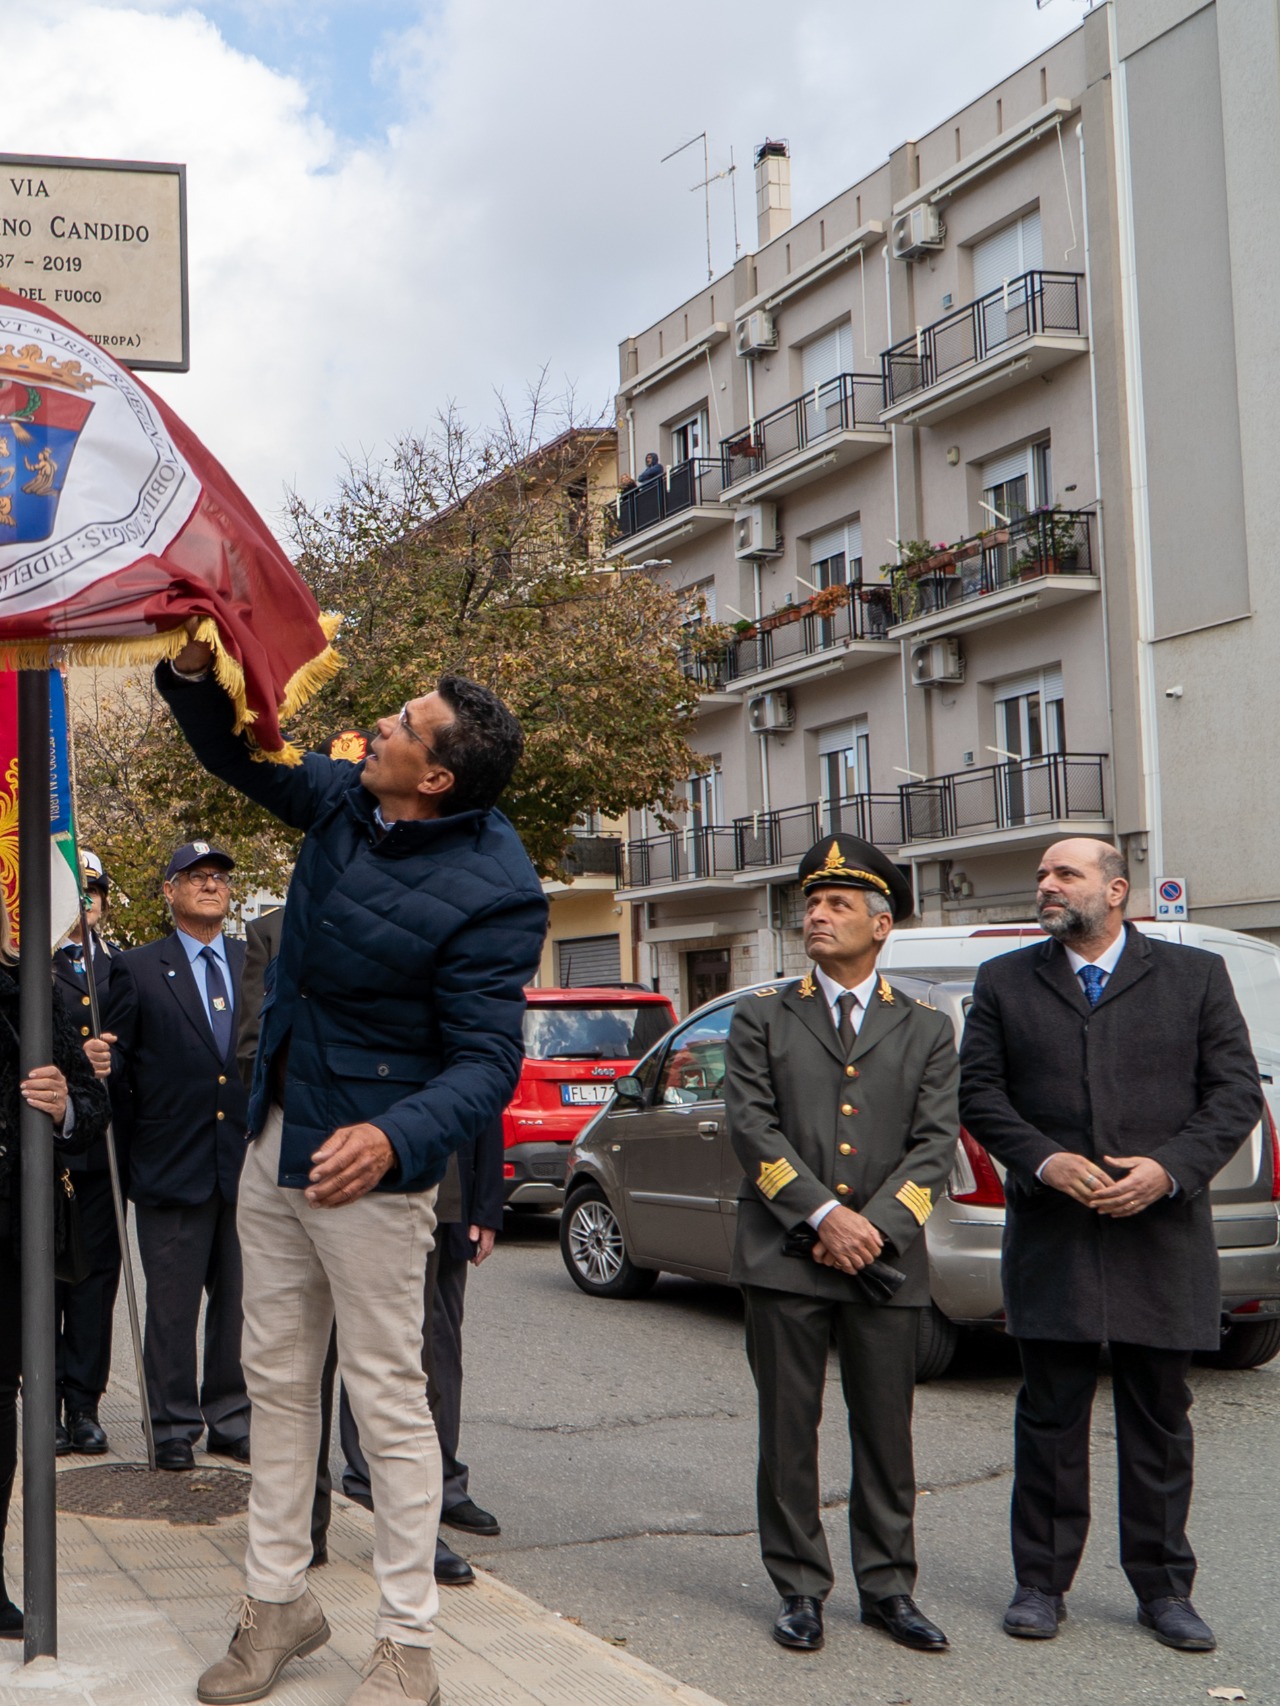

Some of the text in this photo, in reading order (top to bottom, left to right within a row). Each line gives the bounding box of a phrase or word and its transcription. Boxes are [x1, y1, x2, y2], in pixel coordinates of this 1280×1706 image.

[10, 178, 51, 198] VIA
[43, 255, 82, 272] 2019
[18, 287, 102, 305] DEL FUOCO
[591, 1066, 616, 1077] Jeep
